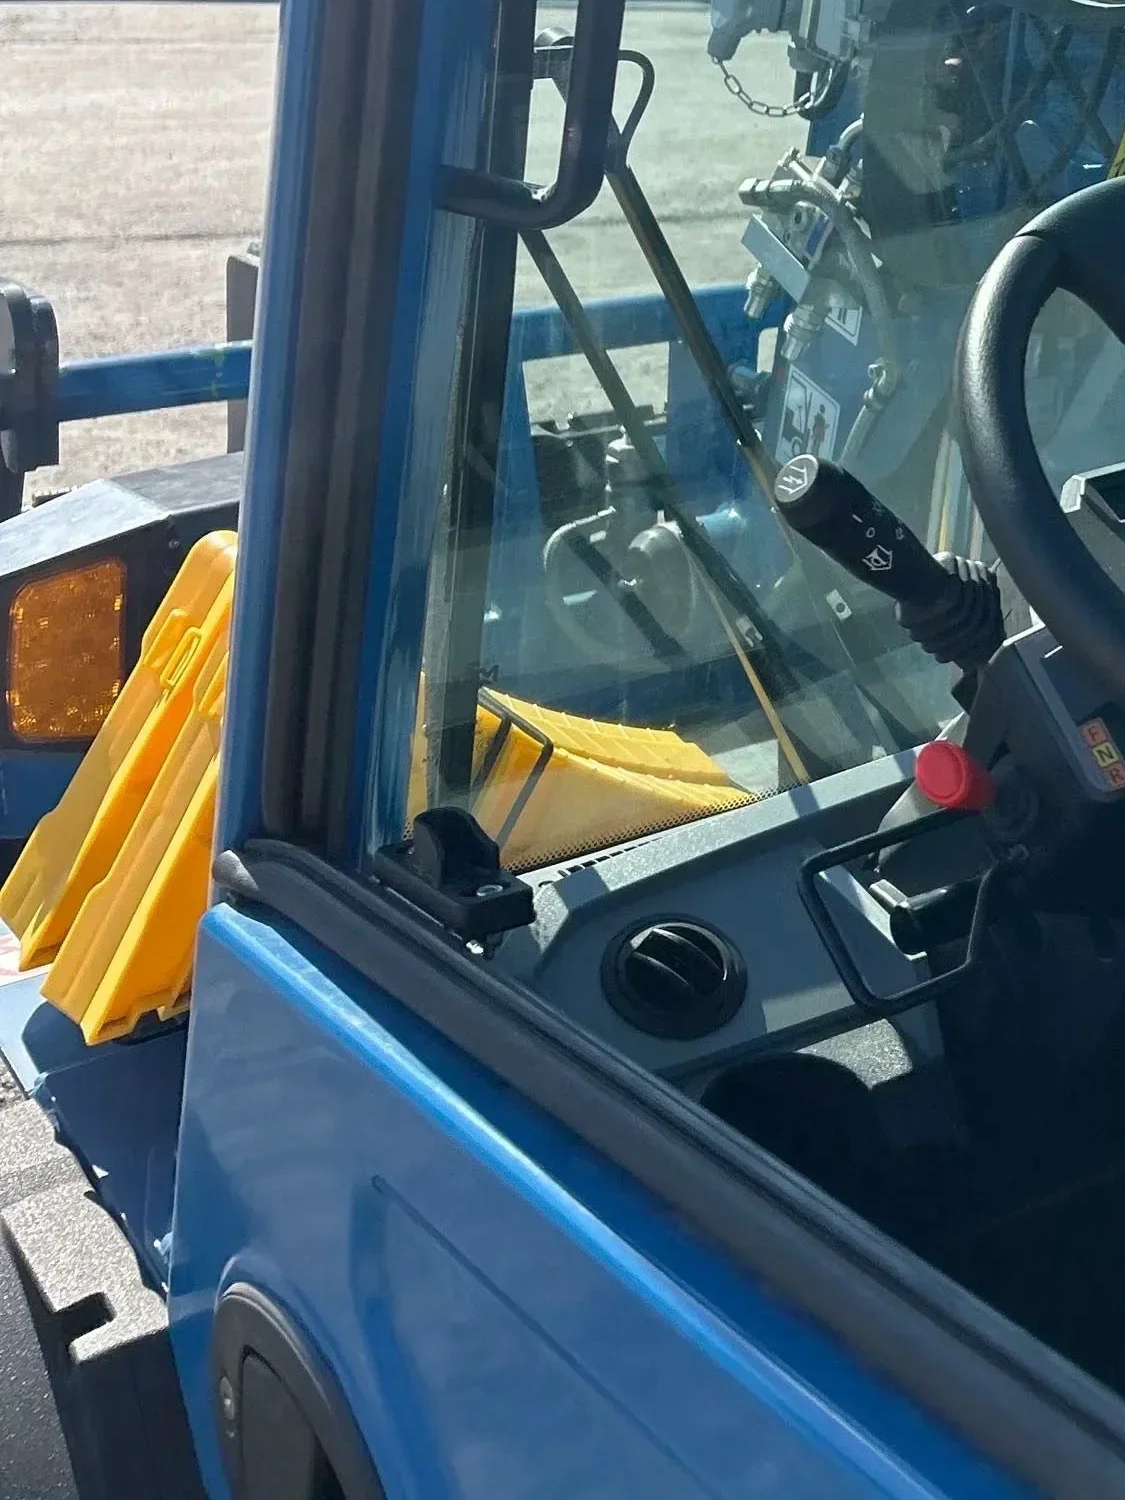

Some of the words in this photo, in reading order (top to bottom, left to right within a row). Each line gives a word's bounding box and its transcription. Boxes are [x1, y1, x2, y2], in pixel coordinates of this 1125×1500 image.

[1087, 726, 1101, 742] F
[1095, 745, 1114, 764] N
[1109, 767, 1125, 785] R
